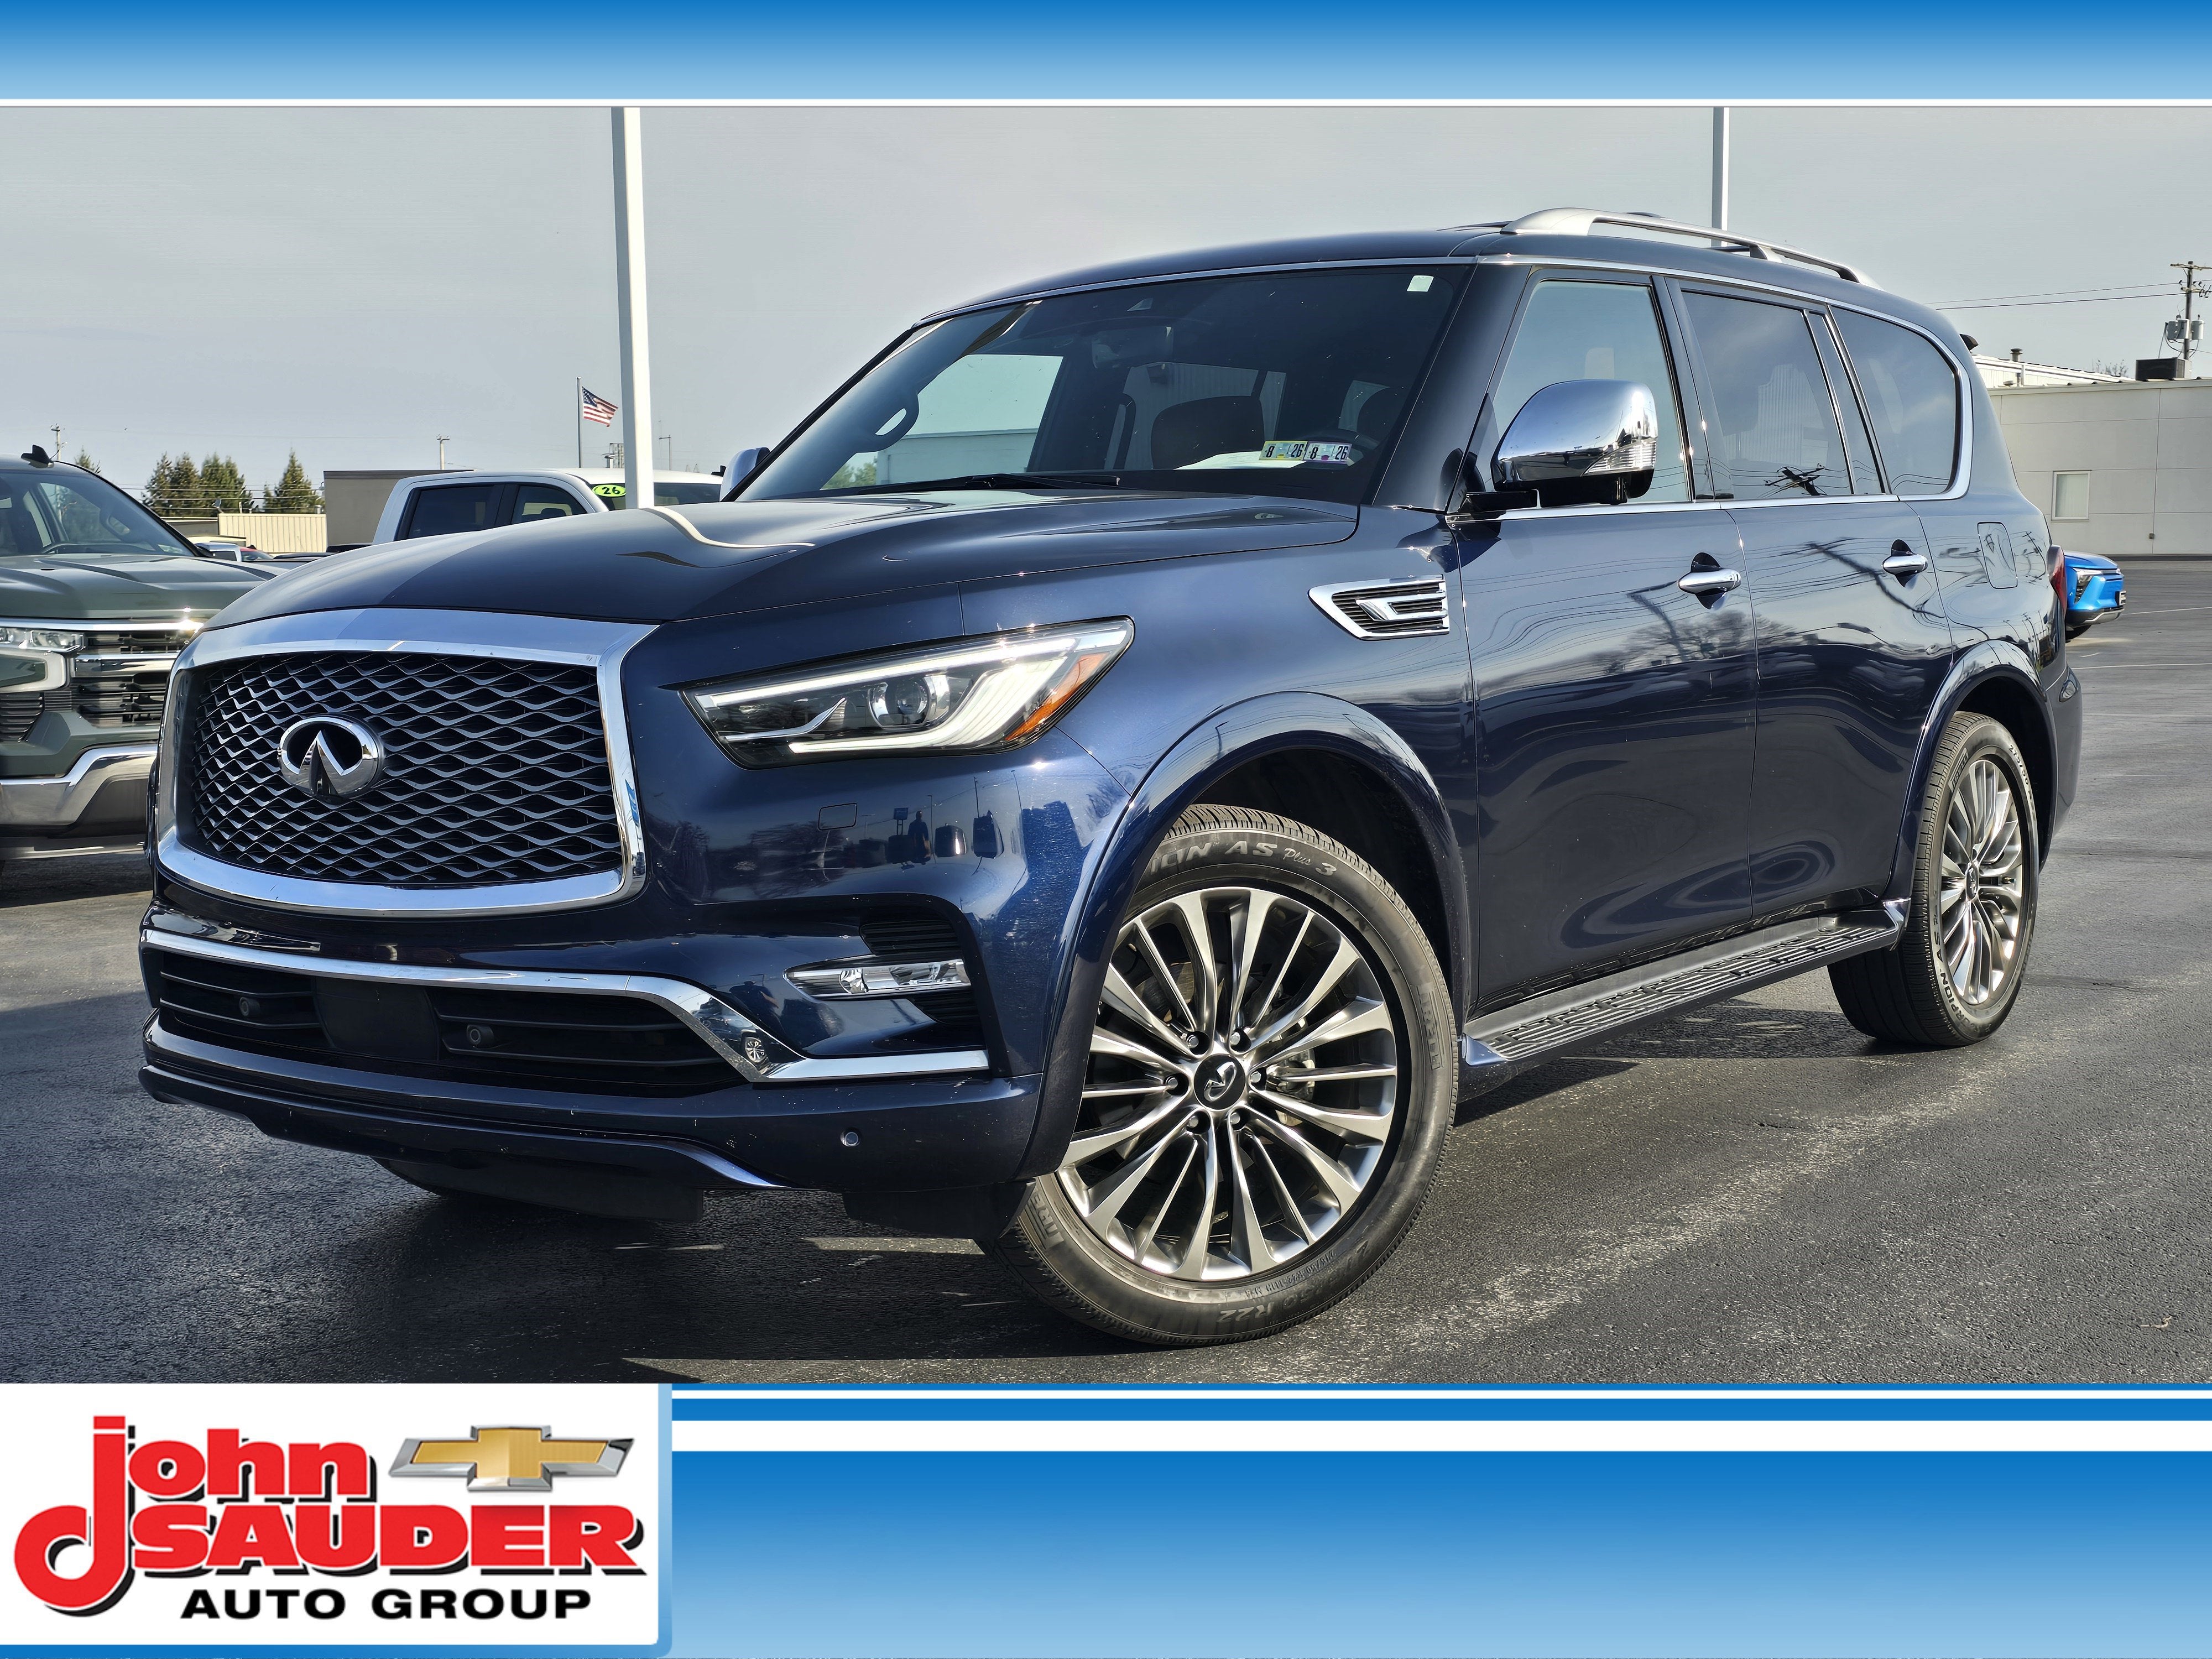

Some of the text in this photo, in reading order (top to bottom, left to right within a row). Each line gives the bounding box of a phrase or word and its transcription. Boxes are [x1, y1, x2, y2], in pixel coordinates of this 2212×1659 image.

[1266, 444, 1305, 458] 8 26
[1310, 446, 1348, 460] 8 26
[1224, 841, 1277, 857] AS
[1282, 847, 1312, 866] Plus
[1315, 862, 1337, 877] 3
[1024, 1186, 1065, 1250] PIRE
